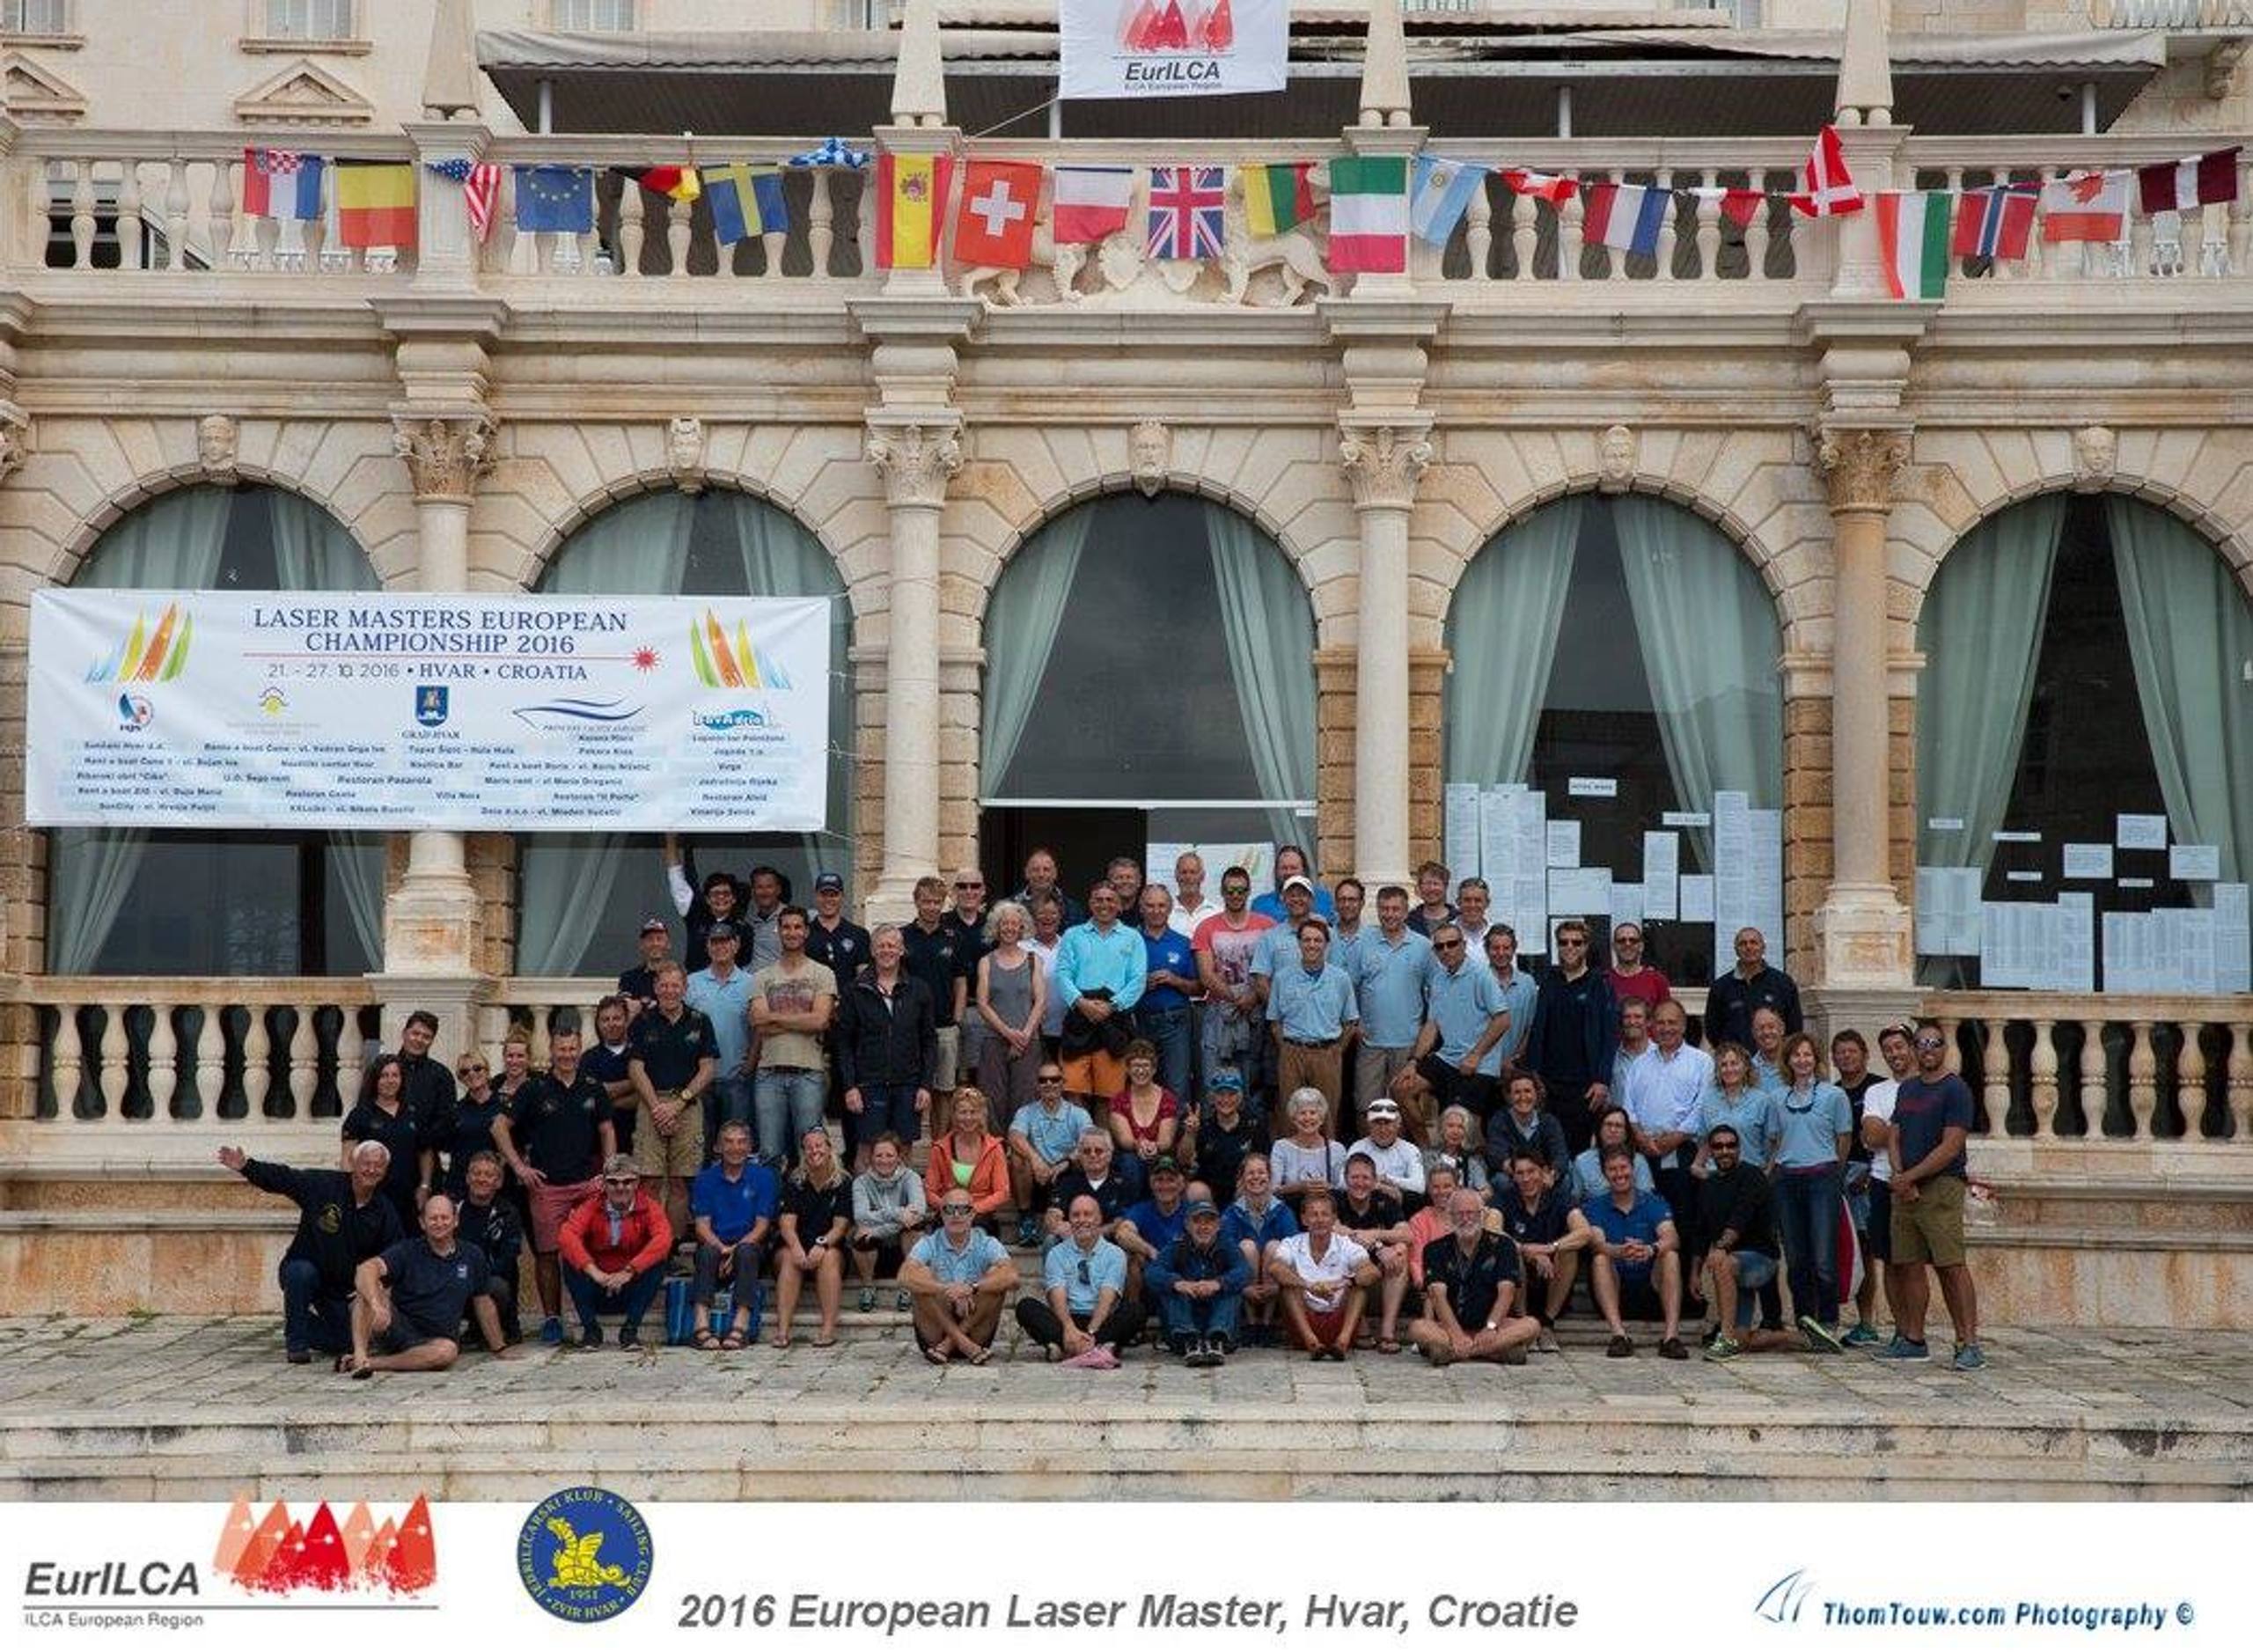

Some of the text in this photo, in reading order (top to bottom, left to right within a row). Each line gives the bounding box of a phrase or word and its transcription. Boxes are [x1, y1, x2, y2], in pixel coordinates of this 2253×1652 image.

[1126, 62, 1220, 80] EurILCA
[254, 608, 627, 631] LASER MASTERS EUROPEAN
[306, 632, 575, 654] CHAMPIONSHIP 2016
[359, 663, 400, 679] 2016
[420, 662, 476, 679] HVAR
[497, 664, 588, 680] CROATIA
